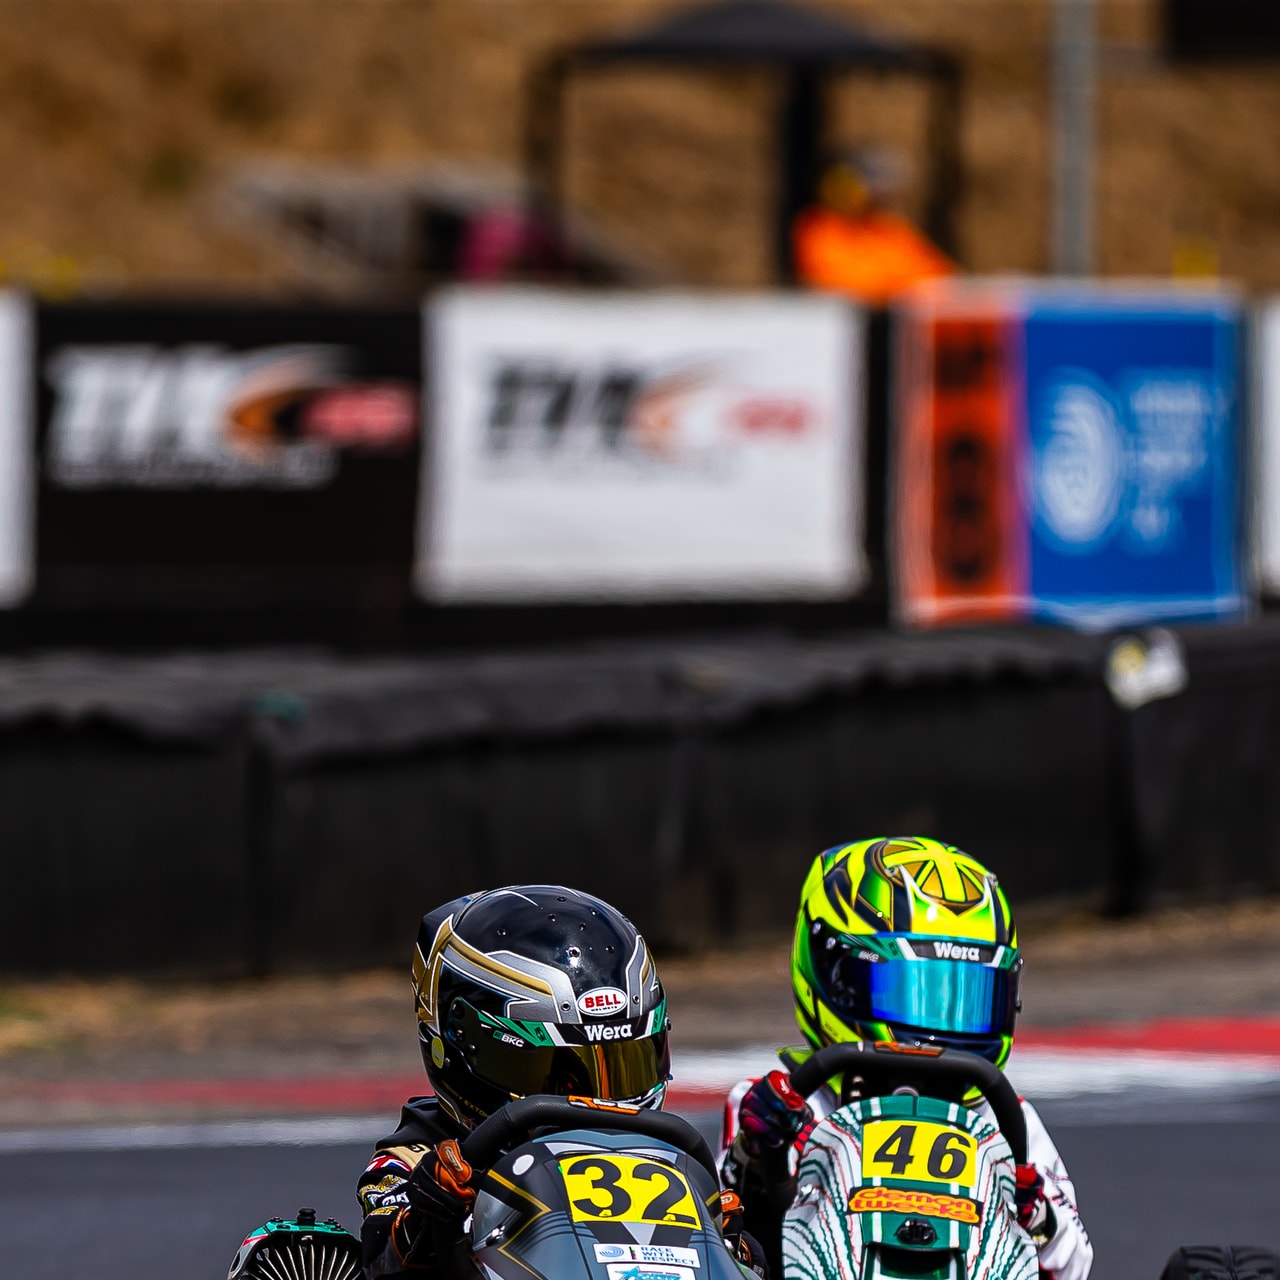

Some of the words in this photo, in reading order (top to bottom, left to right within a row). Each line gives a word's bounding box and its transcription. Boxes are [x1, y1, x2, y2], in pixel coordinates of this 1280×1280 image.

[933, 942, 979, 960] Wera
[585, 993, 621, 1009] BELL
[501, 1034, 525, 1048] BKC
[584, 1024, 632, 1042] Wera
[873, 1125, 971, 1179] 46
[567, 1158, 697, 1226] 32
[859, 1189, 972, 1211] demon
[853, 1199, 976, 1220] tweeks
[643, 1256, 695, 1265] RESPECT
